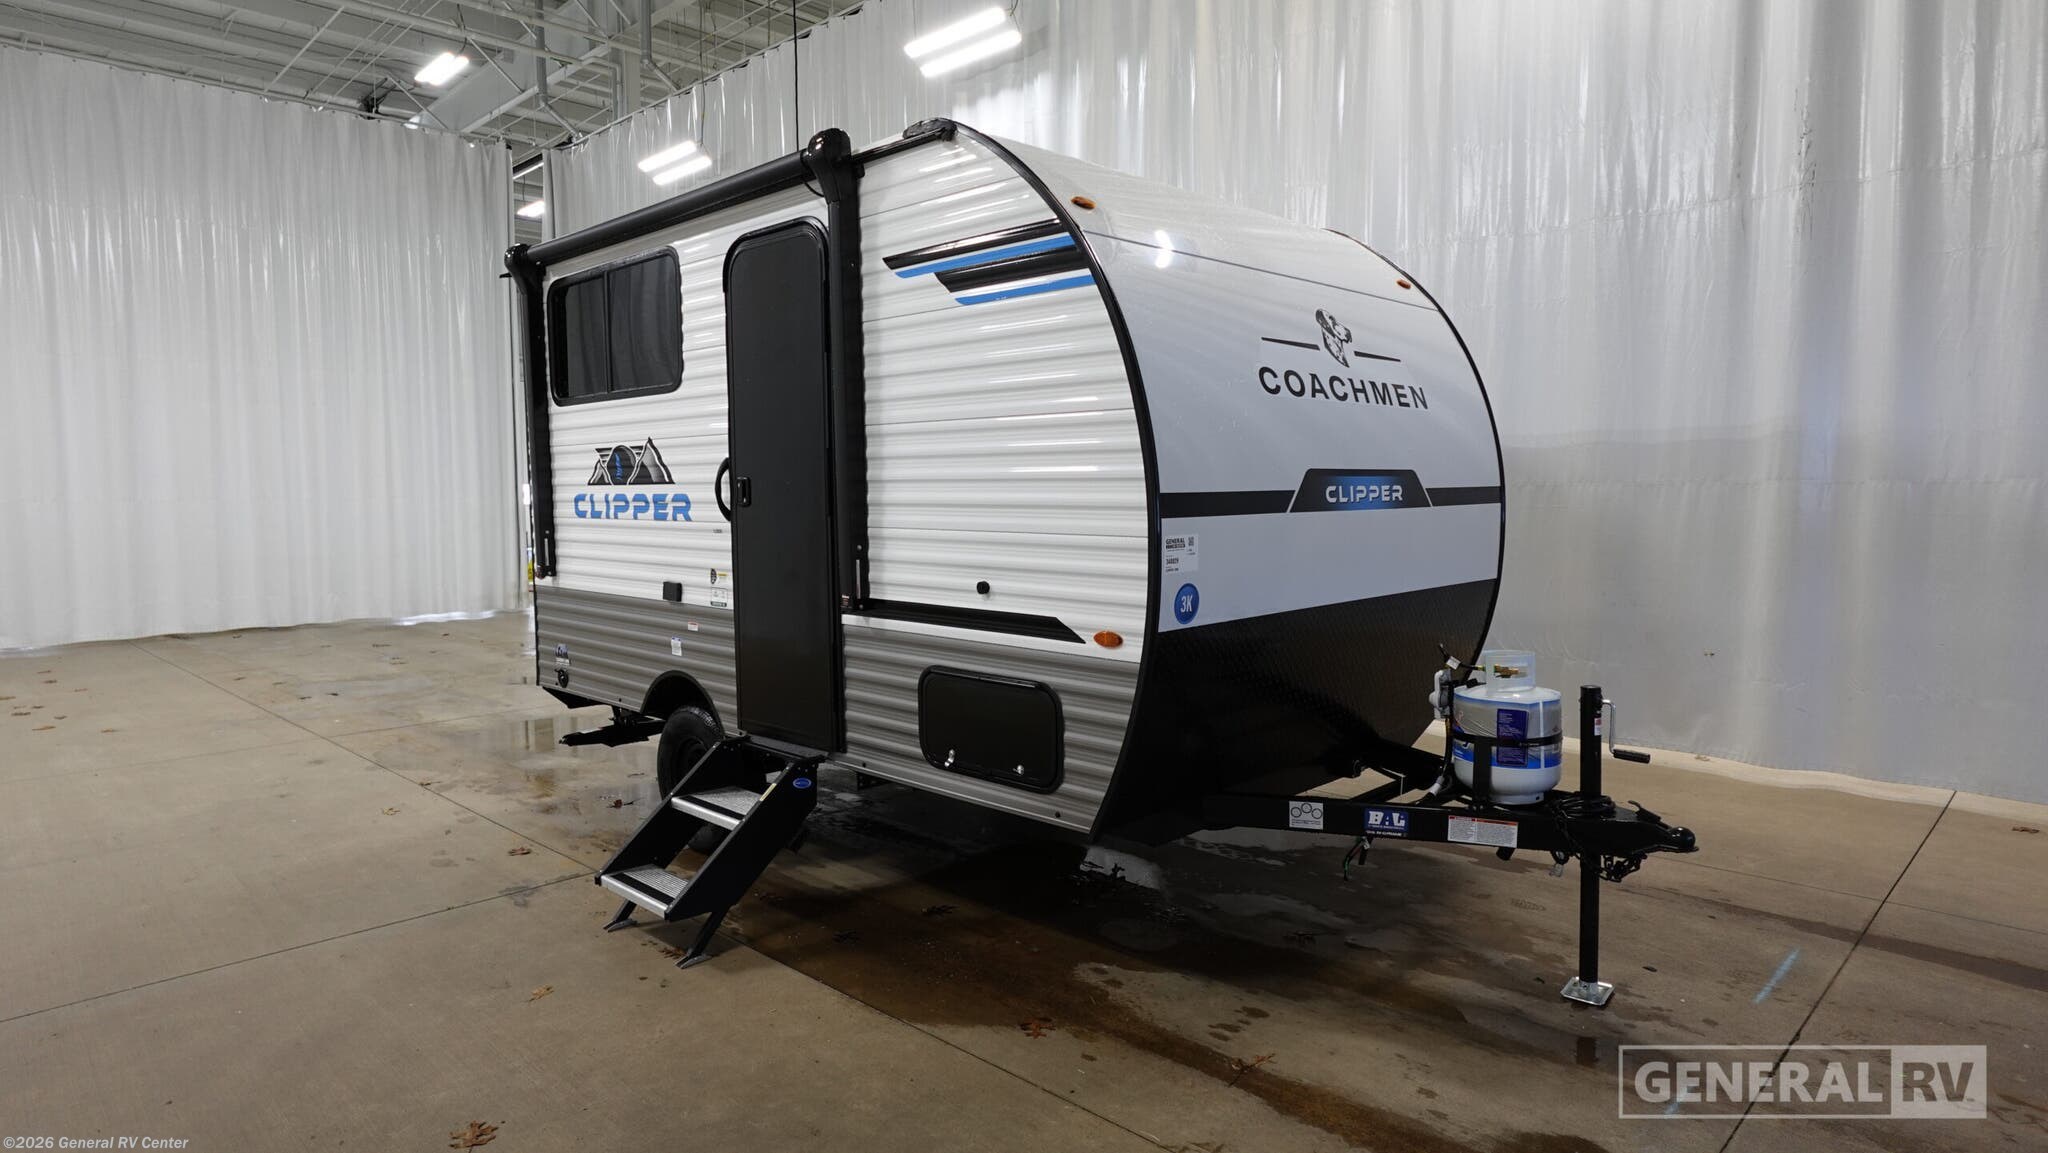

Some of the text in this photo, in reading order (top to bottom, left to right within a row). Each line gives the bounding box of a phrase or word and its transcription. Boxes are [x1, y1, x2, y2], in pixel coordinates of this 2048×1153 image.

[1258, 366, 1428, 410] COACHMEN
[1325, 485, 1403, 503] CLIPPER
[573, 493, 692, 521] CLIPPER
[1180, 595, 1193, 612] 3K
[1368, 810, 1406, 826] BAL
